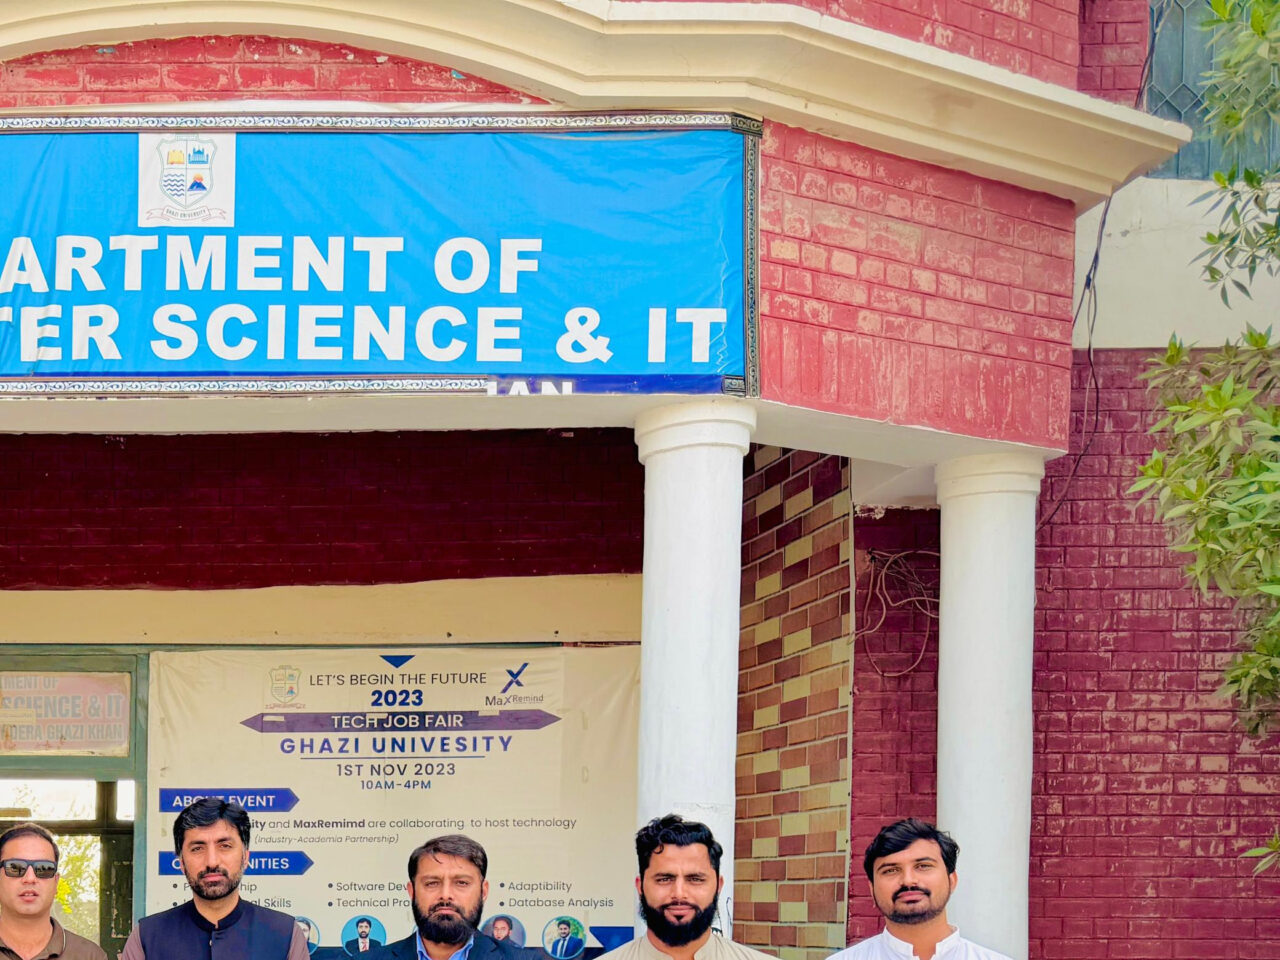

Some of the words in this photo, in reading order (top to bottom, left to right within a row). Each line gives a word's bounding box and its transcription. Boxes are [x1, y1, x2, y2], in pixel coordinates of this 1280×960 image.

[434, 237, 542, 294] OF
[151, 304, 523, 362] SCIENCE
[556, 307, 613, 364] &
[648, 307, 727, 363] IT
[310, 674, 345, 686] LET'S
[350, 673, 394, 685] BEGIN
[401, 673, 426, 685] THE
[431, 672, 487, 684] FUTURE
[371, 689, 424, 707] 2023
[331, 715, 378, 729] TECH
[383, 715, 420, 728] JOB
[424, 714, 463, 728] FAIR
[280, 738, 359, 754] GHAZI
[372, 736, 513, 753] UNIVESITY
[337, 764, 364, 776] 1ST
[370, 763, 407, 776] NOV
[414, 763, 456, 775] 2023
[361, 780, 432, 790] 10AM-4PM
[269, 819, 290, 829] and
[368, 820, 386, 828] are
[389, 818, 464, 830] collaborating
[470, 819, 481, 828] to
[485, 818, 510, 828] host
[513, 818, 577, 830] technology
[336, 881, 385, 891] Software
[508, 881, 572, 893] Adaptibility
[264, 898, 292, 908] Skills
[336, 898, 390, 908] Technical
[508, 897, 565, 908] Database
[568, 897, 614, 909] Analysis
